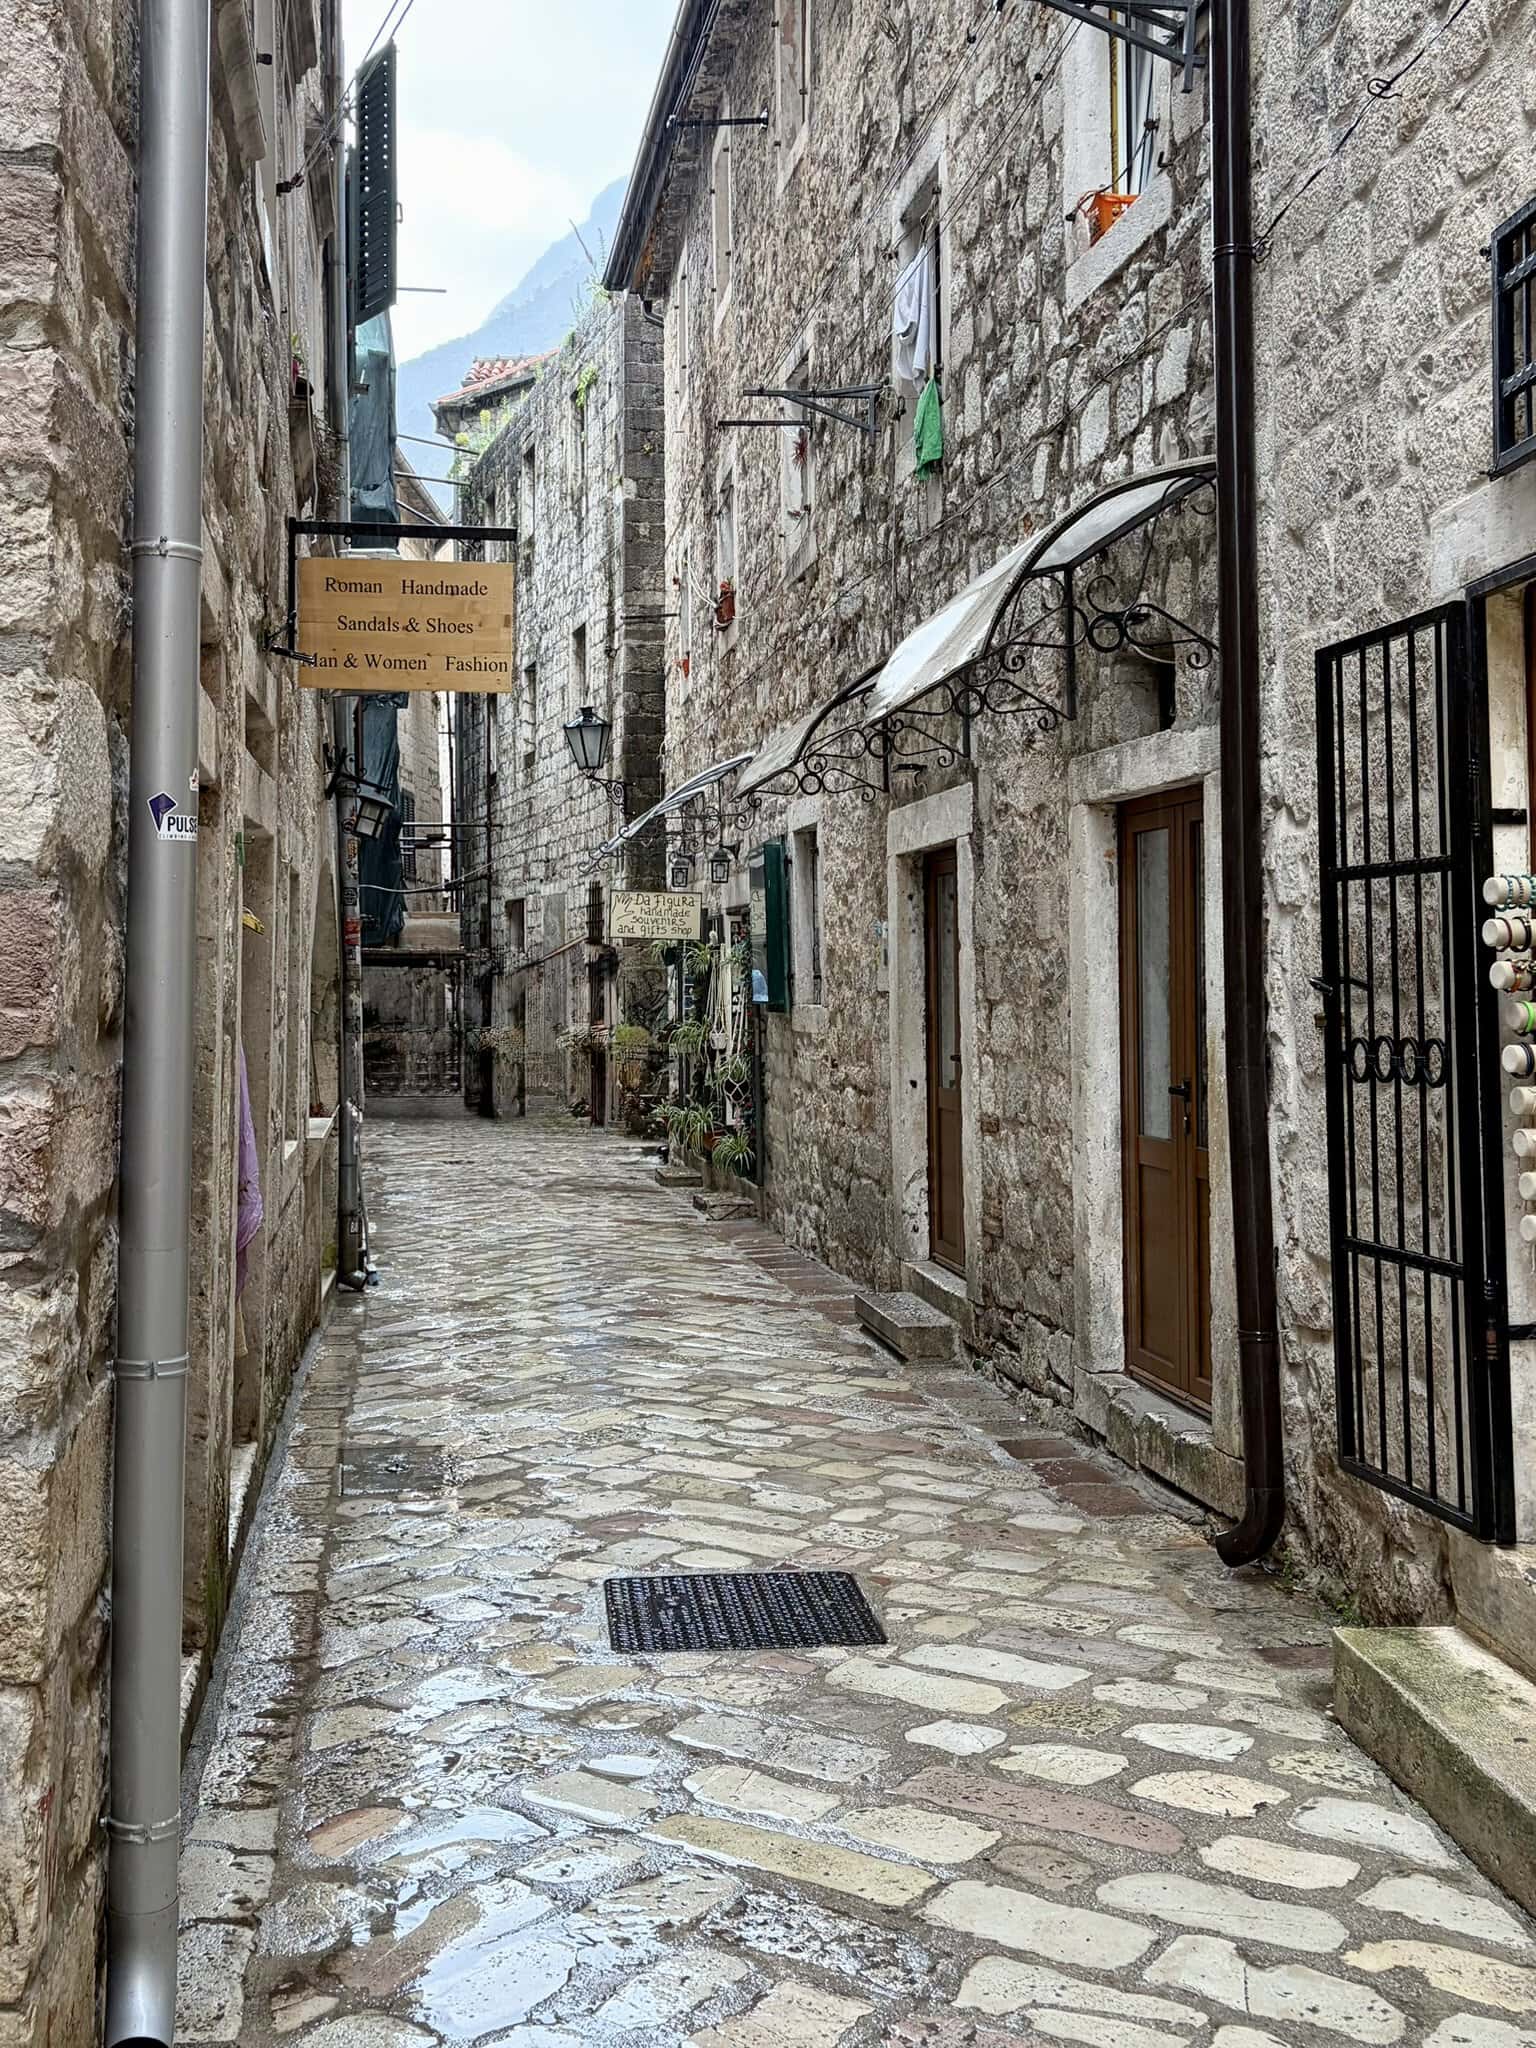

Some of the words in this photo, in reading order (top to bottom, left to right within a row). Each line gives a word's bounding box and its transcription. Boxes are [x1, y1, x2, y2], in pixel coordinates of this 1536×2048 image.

[324, 576, 383, 593] Roman
[401, 579, 488, 596] Handmade
[336, 615, 400, 632] Sandals
[405, 616, 420, 633] &
[425, 617, 474, 634] Shoes
[343, 653, 358, 669] &
[364, 653, 427, 670] Women
[445, 656, 509, 673] Fashion
[634, 893, 651, 906] Da
[617, 924, 635, 934] and
[640, 925, 668, 937] gifts
[670, 926, 693, 938] shop
